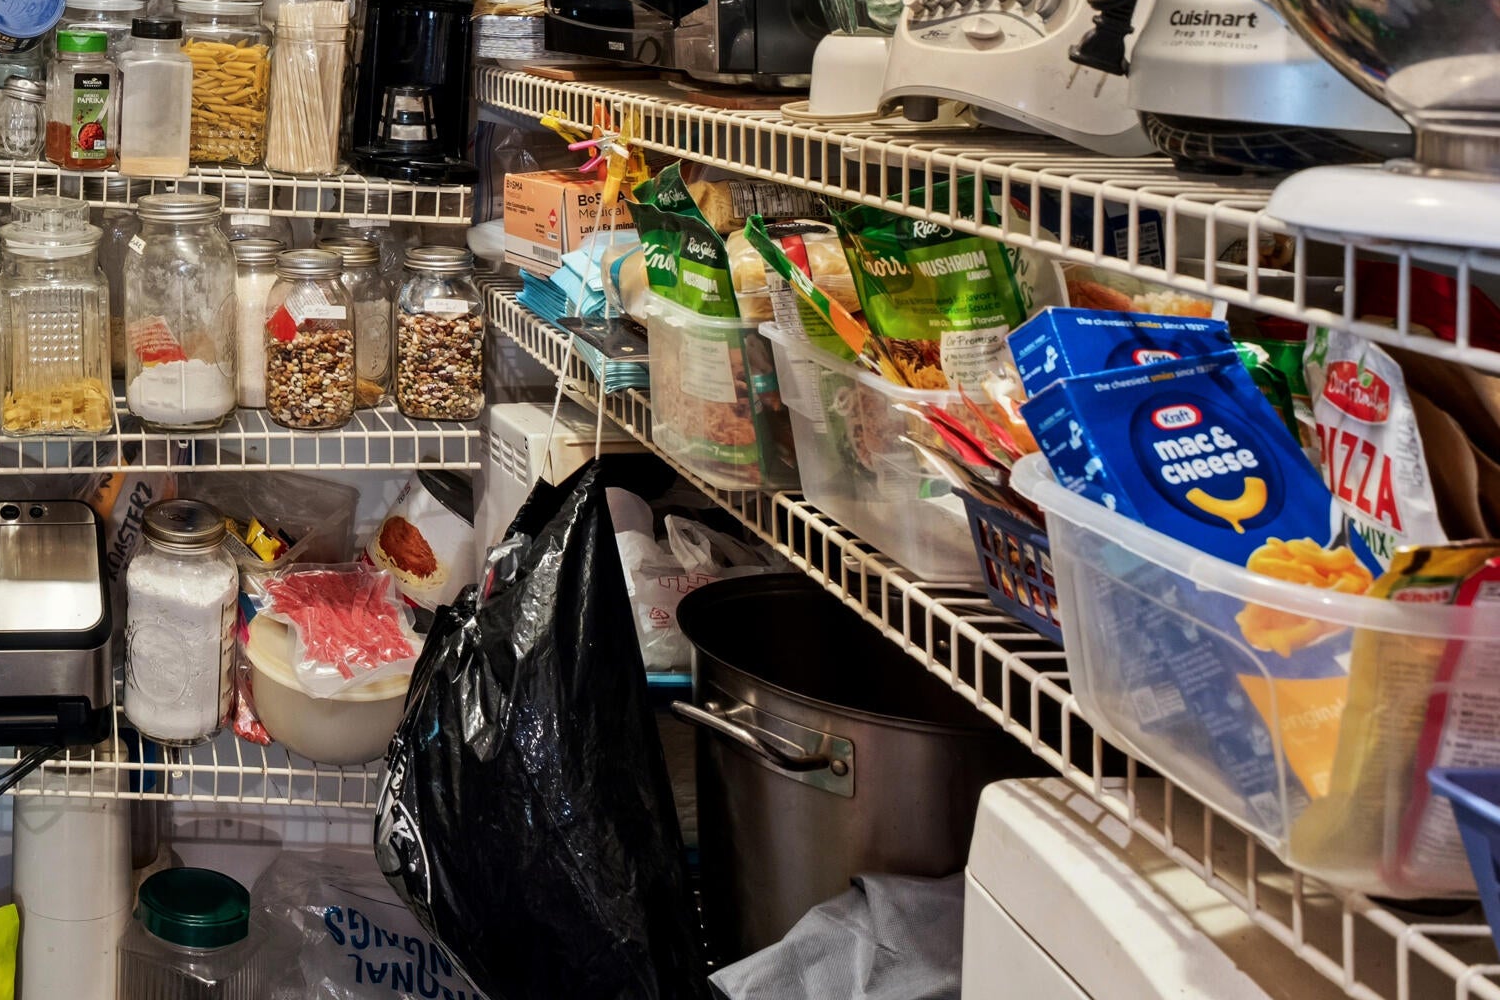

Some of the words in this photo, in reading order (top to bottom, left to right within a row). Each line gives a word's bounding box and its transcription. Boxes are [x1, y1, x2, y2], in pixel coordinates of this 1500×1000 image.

[1170, 9, 1259, 29] Cuisinart
[1173, 30, 1199, 41] Prep
[1200, 30, 1211, 39] 11
[77, 97, 104, 106] PAPRIKA
[913, 219, 940, 239] Rice
[916, 250, 989, 278] MUSHROOM
[972, 314, 1006, 326] Flavors
[1076, 317, 1093, 327] the
[1092, 317, 1134, 328] cheesiest
[1134, 319, 1162, 330] smiles
[1162, 321, 1186, 332] since
[960, 333, 999, 346] Promise
[1094, 381, 1111, 393] the
[1110, 374, 1151, 390] cheesiest
[1150, 371, 1176, 383] smiles
[1175, 367, 1196, 379] since
[1327, 369, 1349, 395] Our
[1348, 380, 1389, 416] Family
[1161, 407, 1193, 424] Kraft
[1153, 432, 1216, 462] mac
[1209, 425, 1238, 450] &
[1160, 448, 1259, 485] cheese
[1359, 522, 1390, 560] MIX
